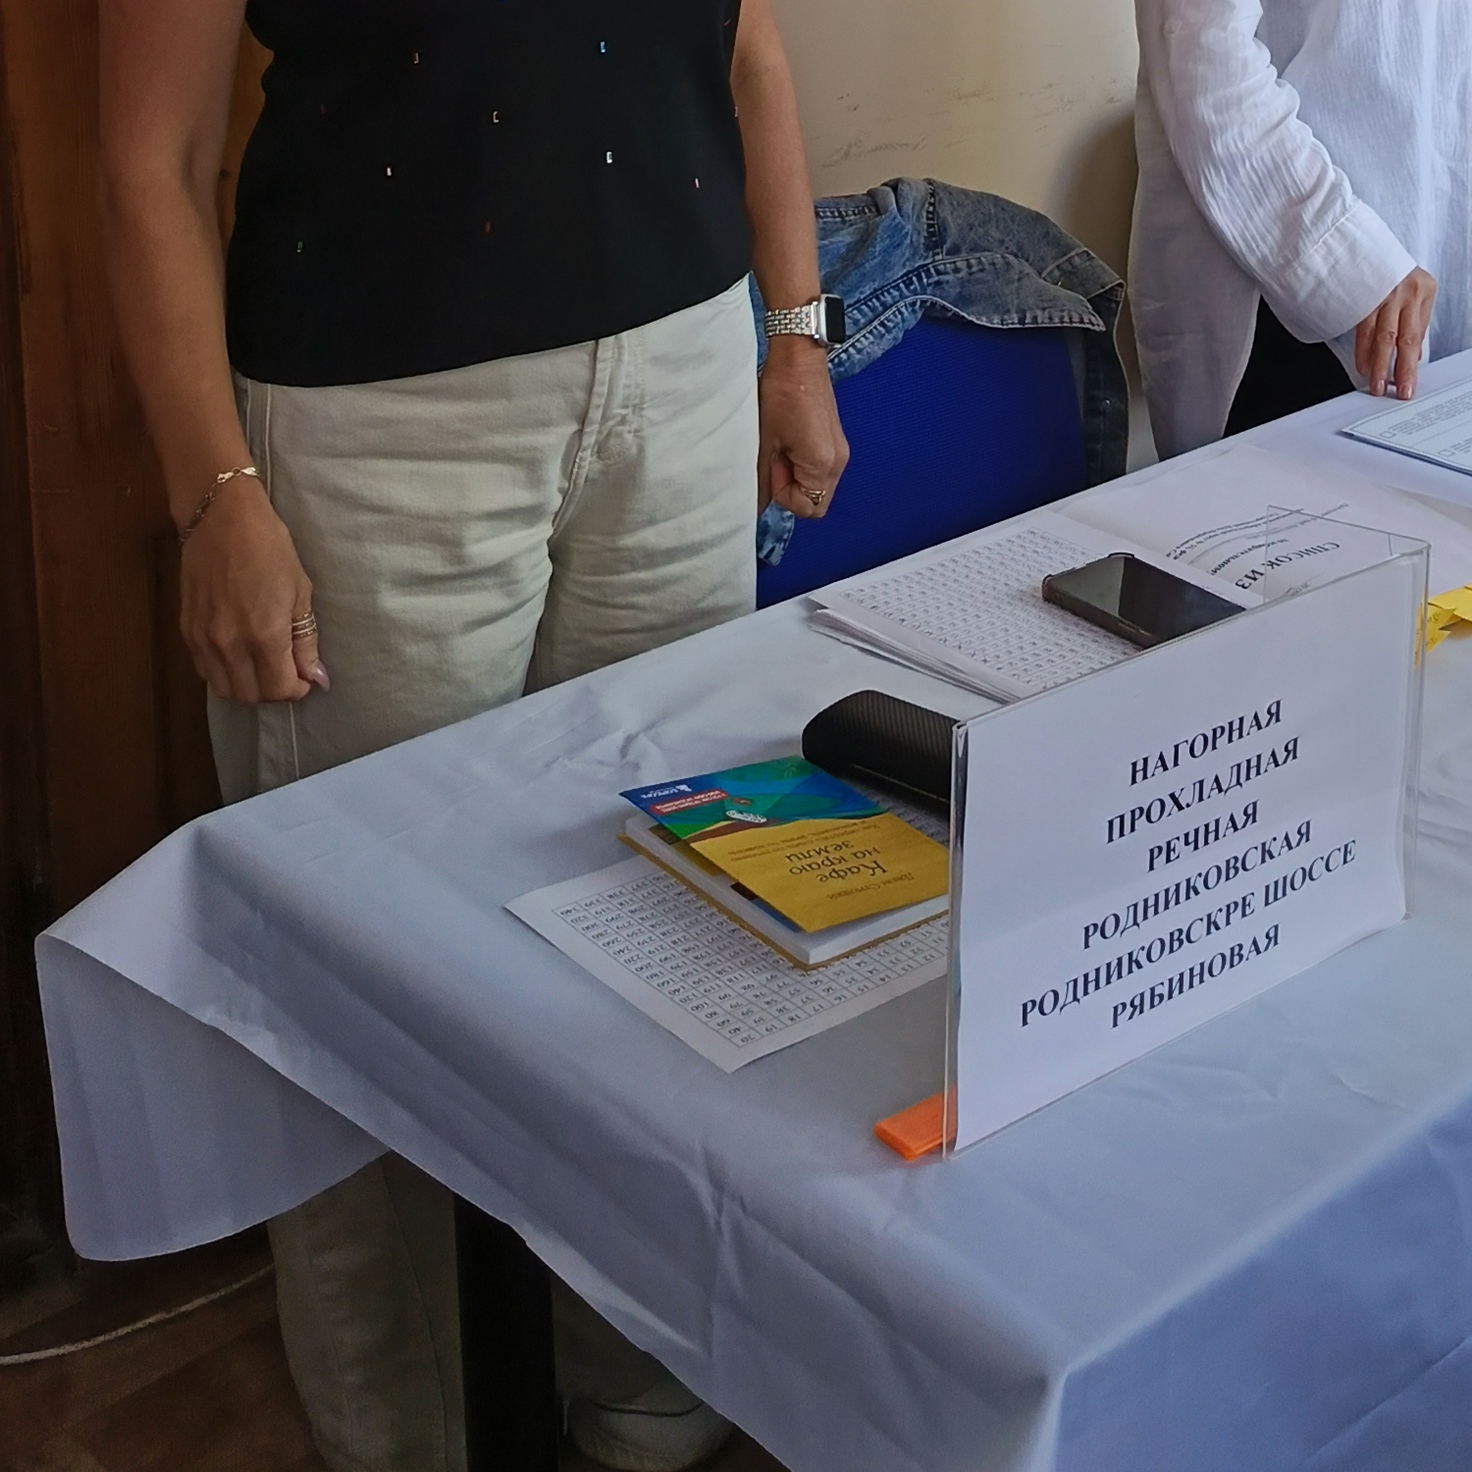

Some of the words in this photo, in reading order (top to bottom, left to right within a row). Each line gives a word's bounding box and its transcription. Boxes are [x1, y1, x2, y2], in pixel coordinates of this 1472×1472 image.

[1261, 542, 1340, 570] СПИСОК
[1129, 698, 1283, 787] НАГОРНАЯ
[1106, 736, 1299, 844] ПРОХЛАДНАЯ
[785, 840, 854, 863] земли
[788, 855, 848, 876] краю
[815, 859, 888, 883] Кафе
[851, 846, 881, 860] на
[1146, 799, 1259, 873] РЕЧНАЯ
[1082, 819, 1312, 950] РОДНИКОВСКАЯ
[1020, 892, 1255, 1028] РОДНИКОВСКРЕ
[1263, 840, 1356, 908] ШОССЕ
[1111, 923, 1281, 1028] РЯБИНОВАЯ
